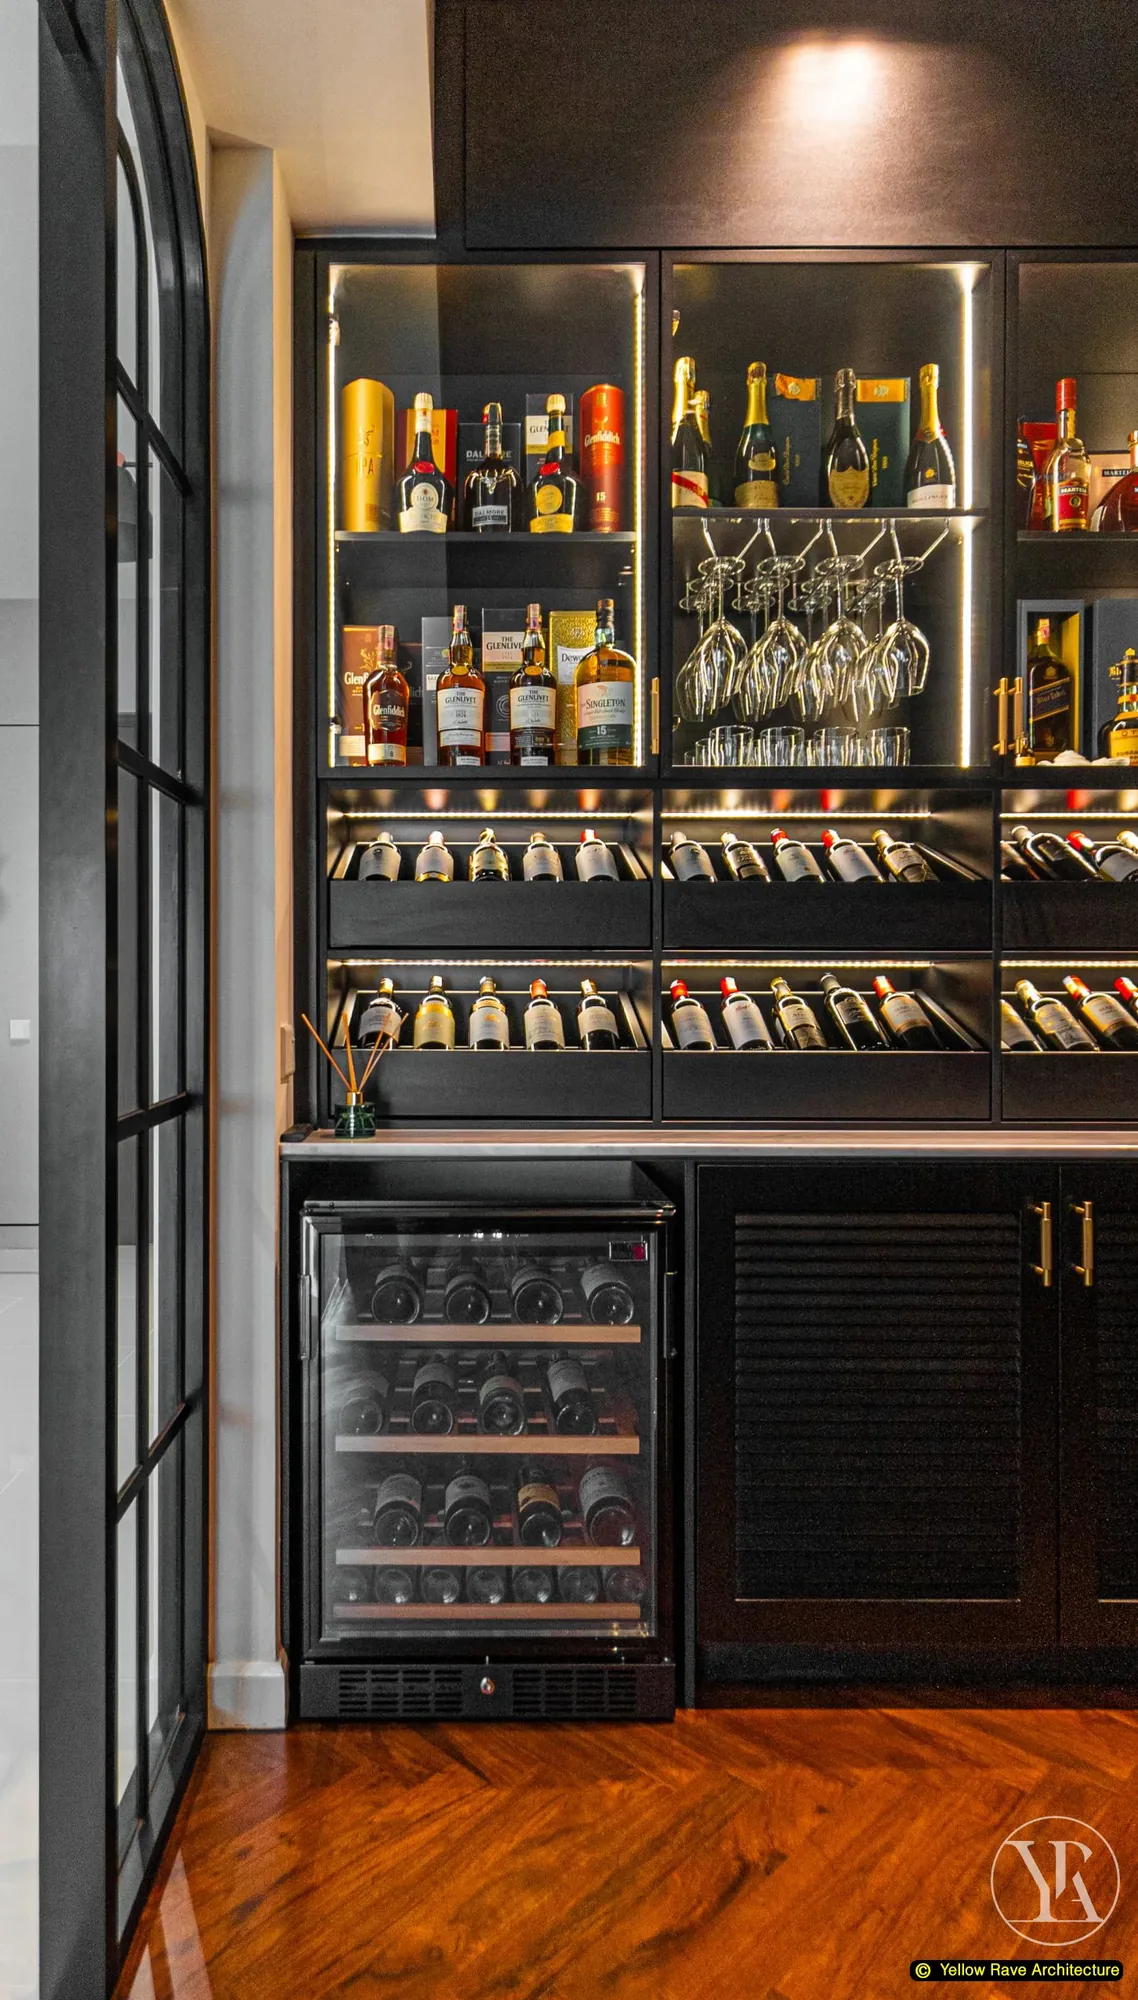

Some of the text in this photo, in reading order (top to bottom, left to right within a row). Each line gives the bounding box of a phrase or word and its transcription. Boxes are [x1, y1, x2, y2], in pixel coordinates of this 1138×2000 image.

[529, 424, 570, 433] GLENT
[584, 430, 620, 447] Glenfiddich
[466, 450, 512, 458] DALRE
[486, 642, 523, 650] GLENLIVE
[444, 696, 476, 704] GLENLIVET
[517, 694, 549, 702] GLENLIVET
[586, 699, 626, 709] SINGLETON
[373, 704, 405, 717] Glenfiddich
[596, 725, 607, 735] 15
